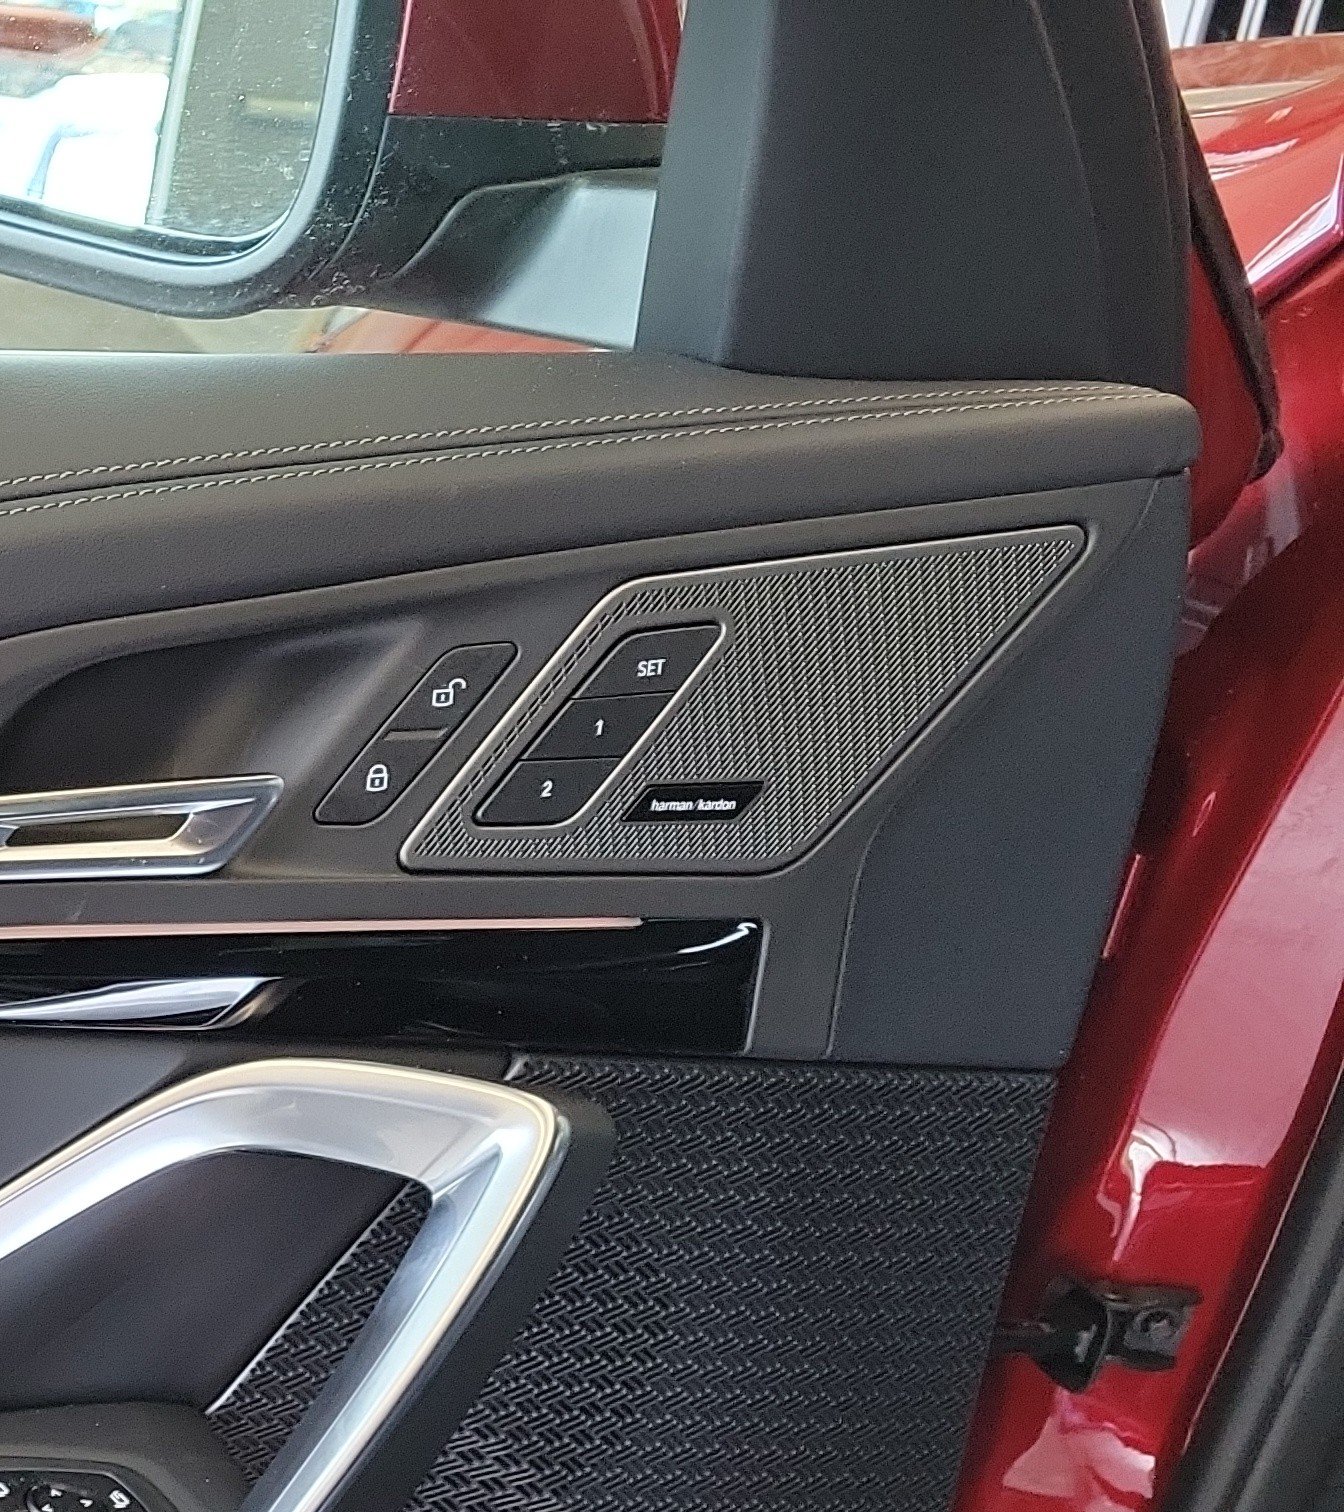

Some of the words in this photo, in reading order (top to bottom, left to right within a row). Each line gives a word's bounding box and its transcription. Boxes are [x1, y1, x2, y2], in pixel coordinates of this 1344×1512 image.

[637, 658, 666, 677] SET
[595, 718, 604, 736] 1
[540, 780, 553, 798] 2
